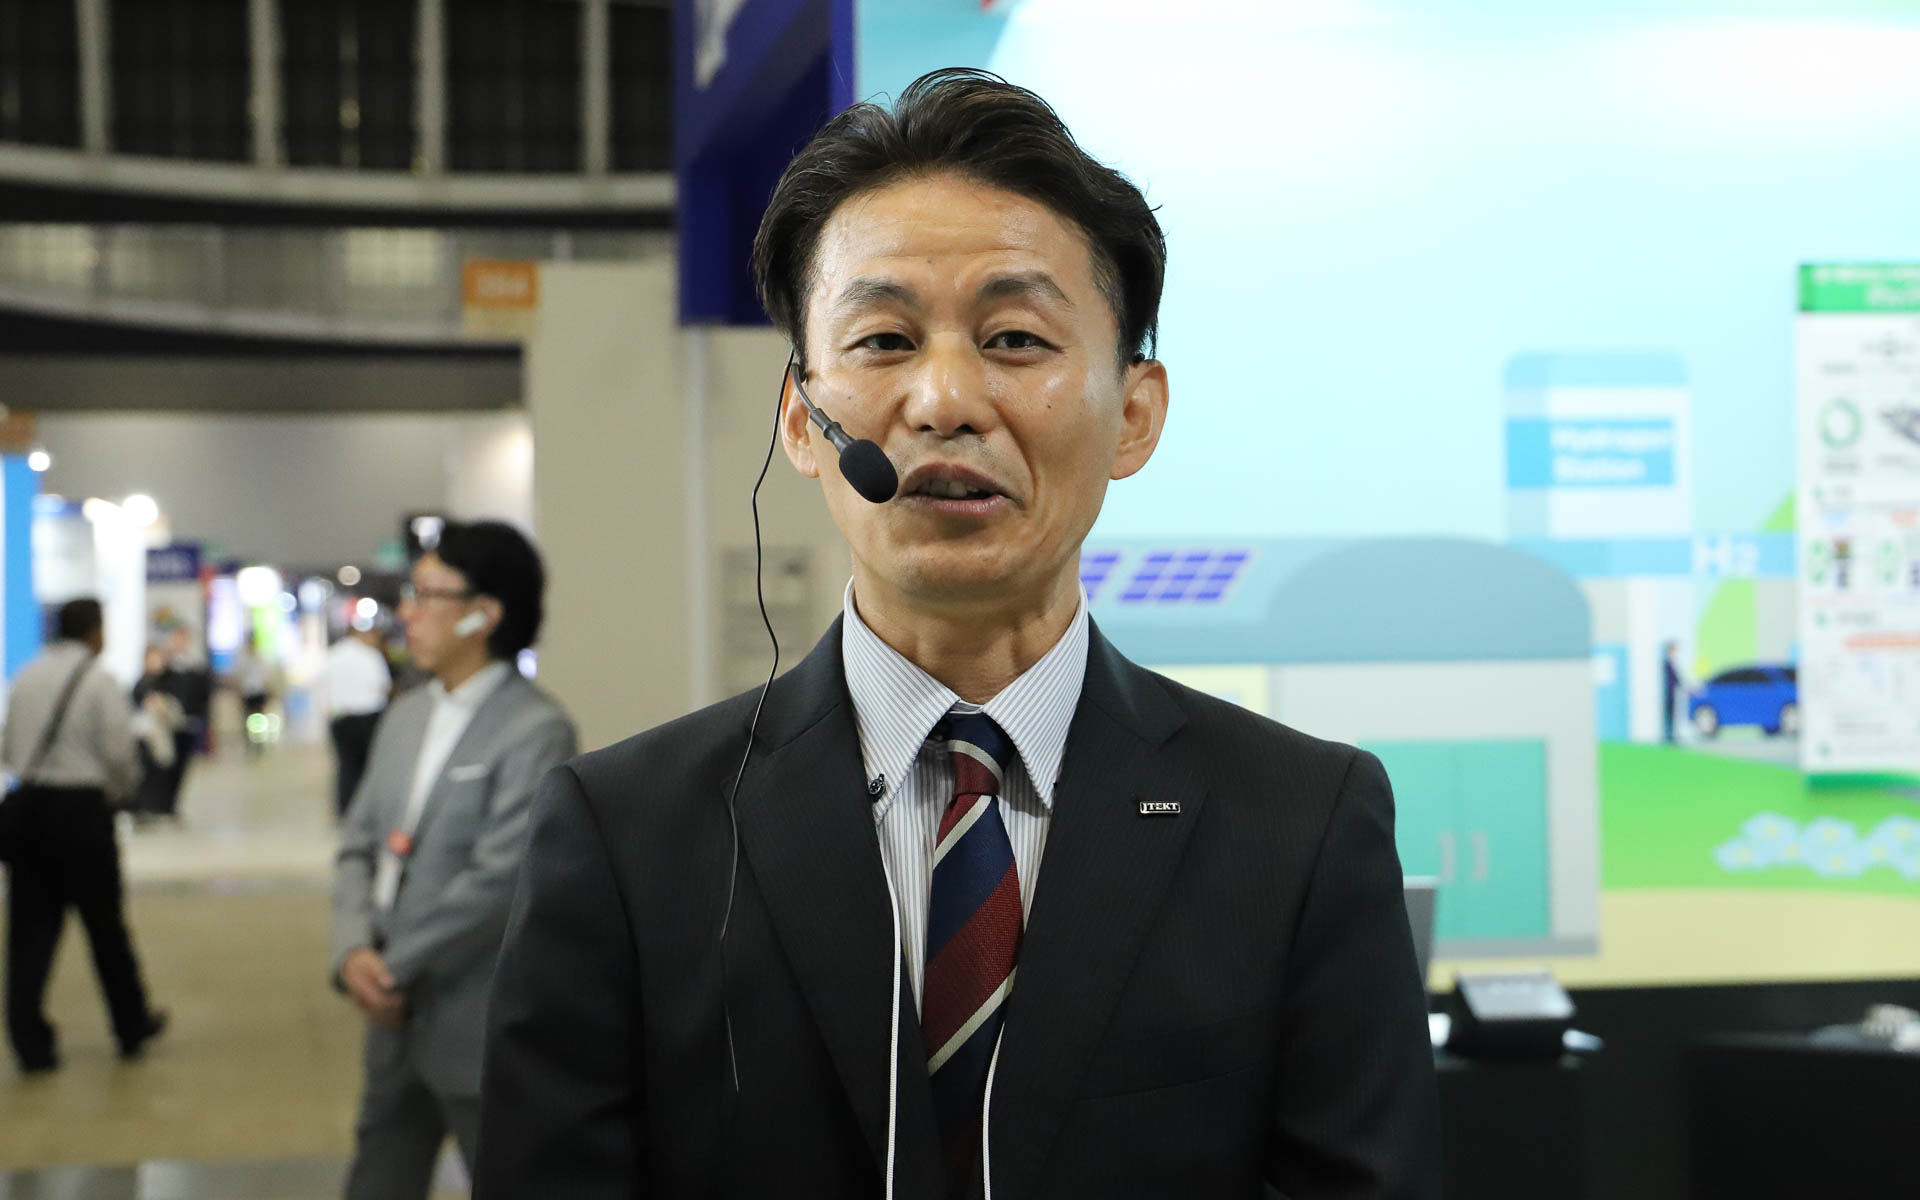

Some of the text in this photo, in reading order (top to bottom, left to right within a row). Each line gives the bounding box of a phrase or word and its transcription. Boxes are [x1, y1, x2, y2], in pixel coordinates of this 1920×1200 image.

[1553, 455, 1646, 481] Station
[1692, 537, 1760, 575] H2
[1141, 802, 1178, 812] JTEKT
